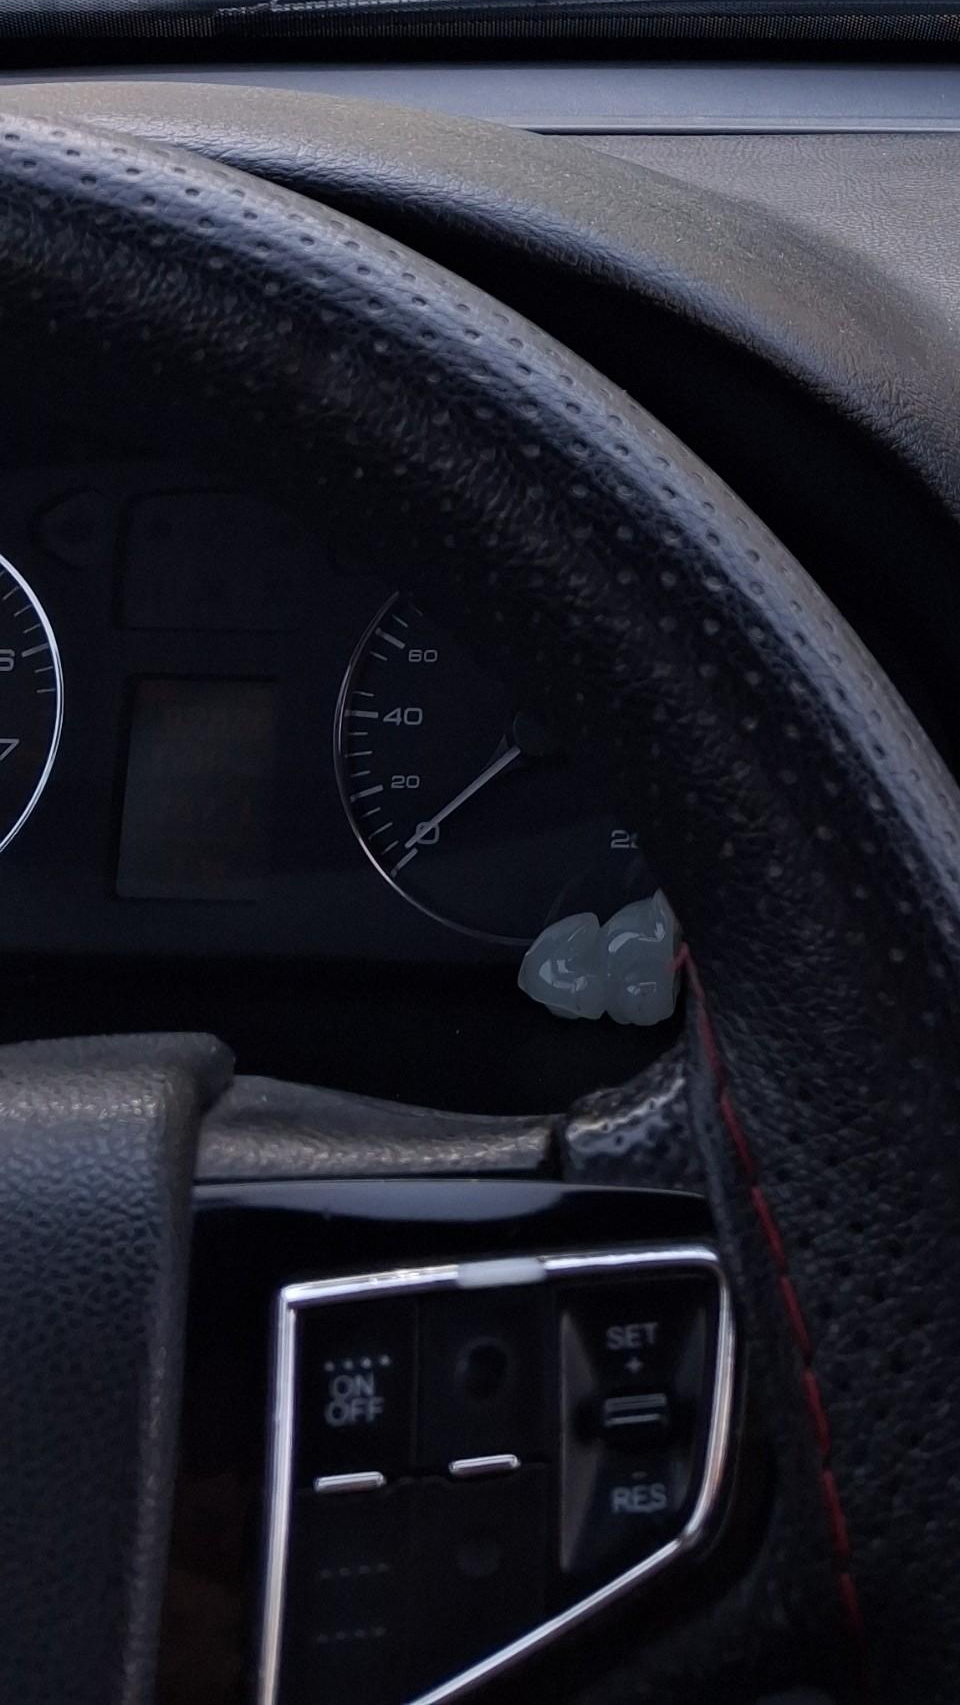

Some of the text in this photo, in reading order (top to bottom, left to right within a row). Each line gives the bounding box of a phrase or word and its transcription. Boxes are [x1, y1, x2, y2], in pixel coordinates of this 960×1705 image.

[408, 649, 438, 662] 60
[383, 707, 424, 726] 40
[391, 775, 420, 789] 20
[606, 1322, 659, 1350] SET
[330, 1374, 374, 1399] ON
[324, 1397, 384, 1427] OFF
[611, 1484, 667, 1514] RES
